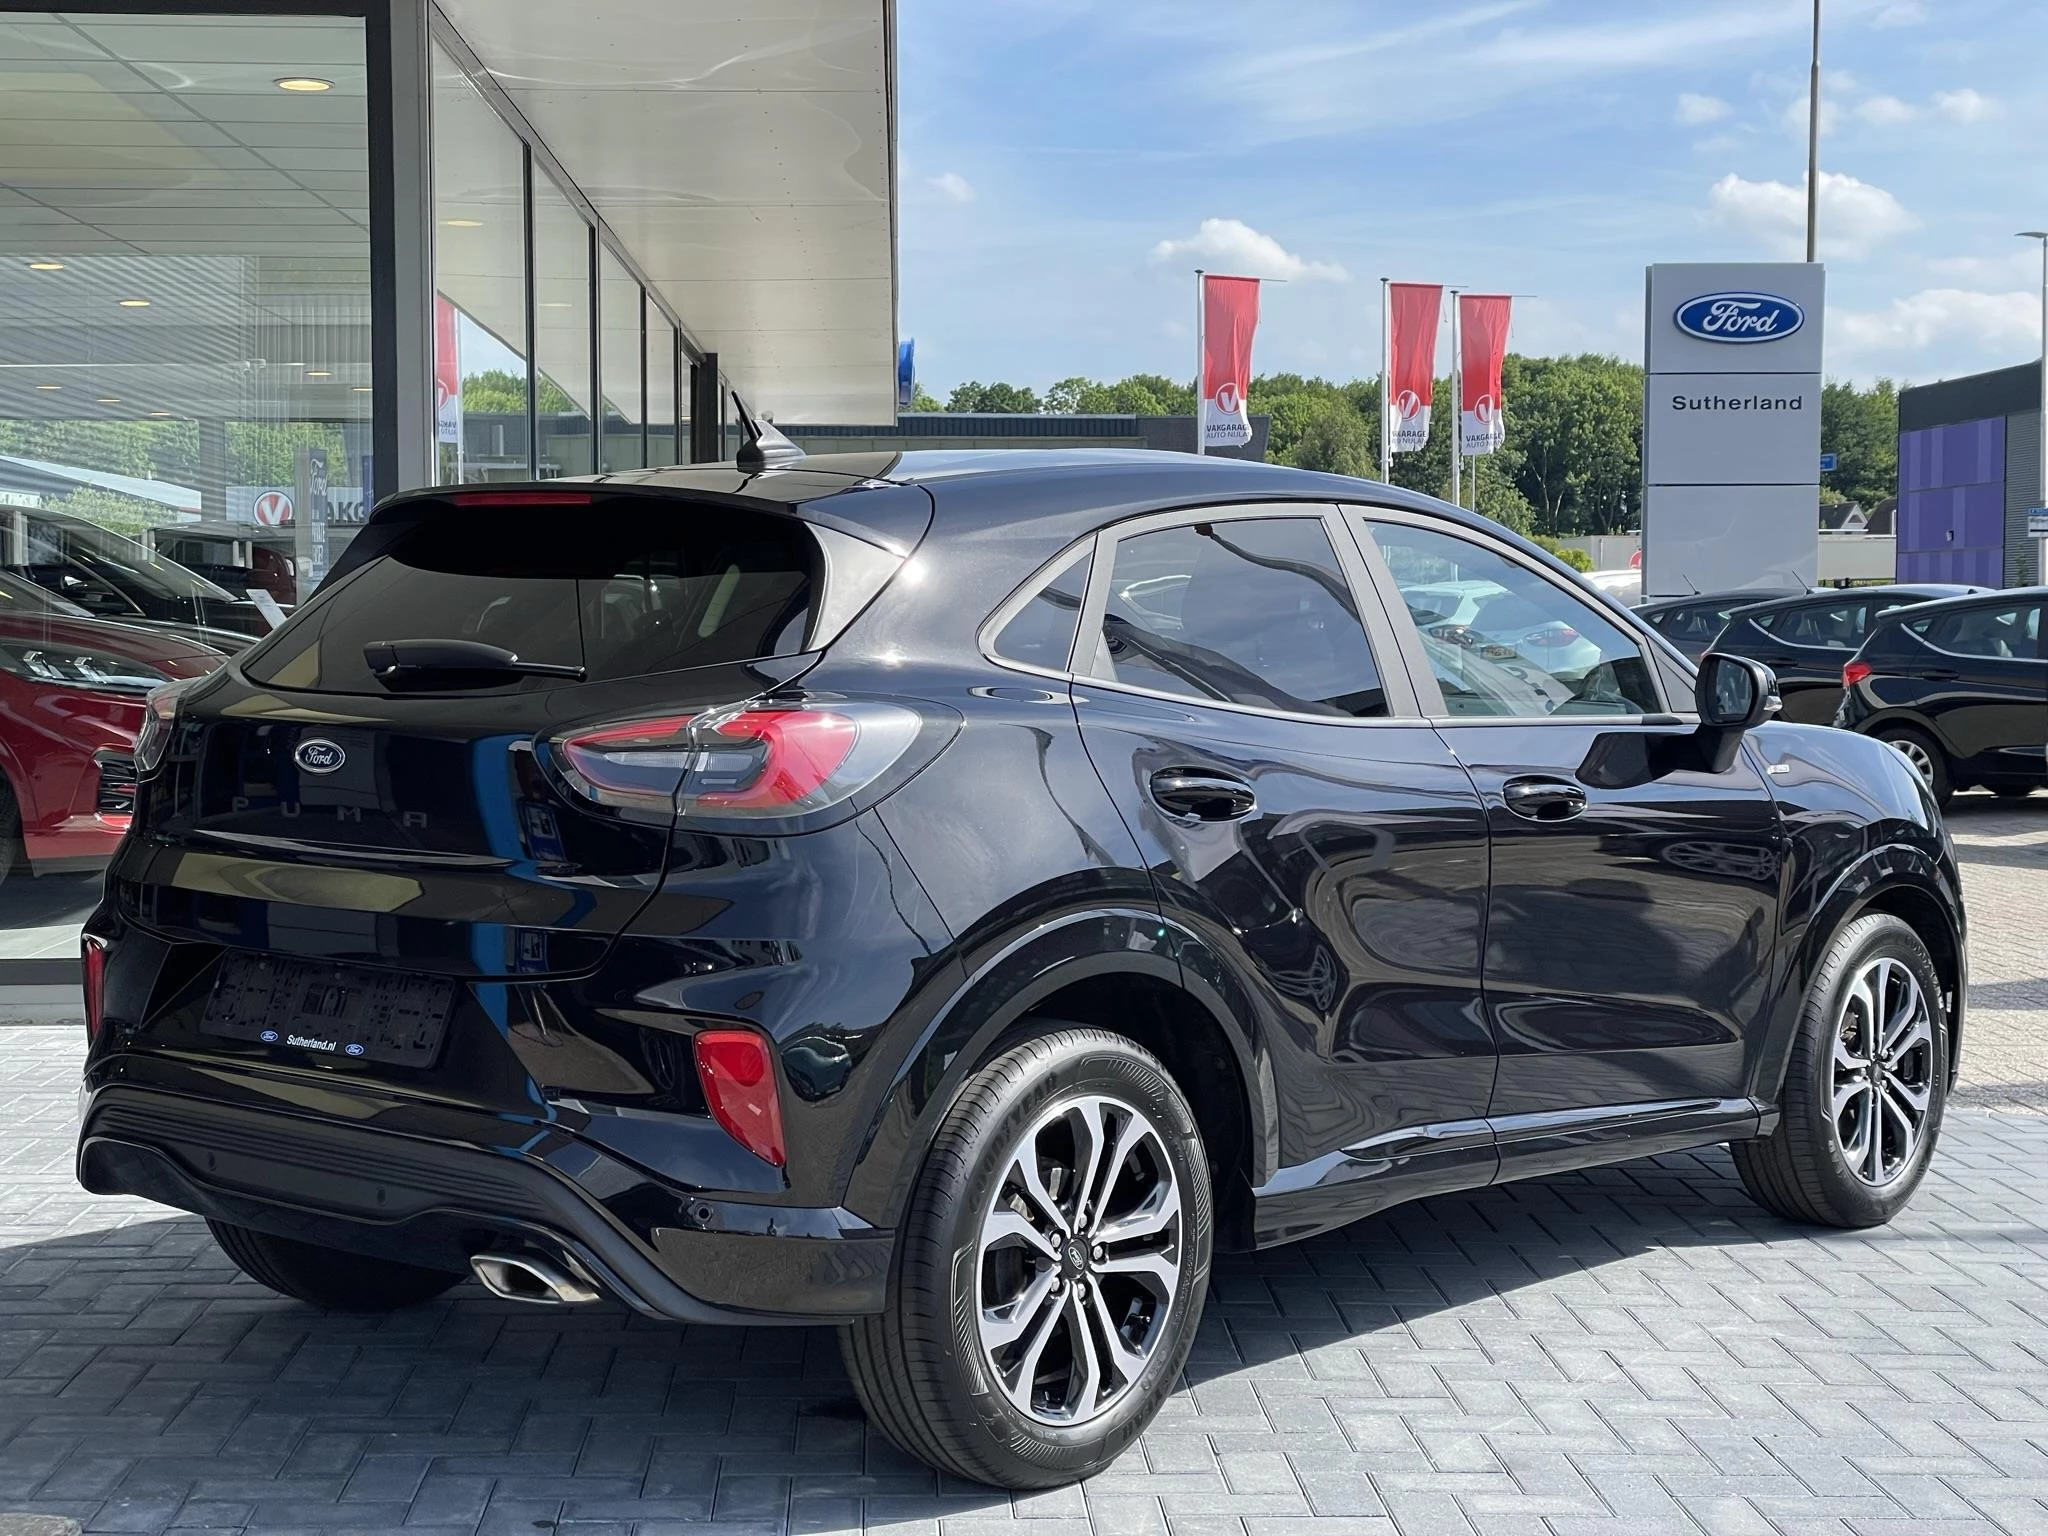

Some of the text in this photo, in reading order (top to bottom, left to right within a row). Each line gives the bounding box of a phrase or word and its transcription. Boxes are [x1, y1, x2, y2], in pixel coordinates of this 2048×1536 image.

[1703, 300, 1780, 332] Ford
[1672, 395, 1802, 410] Sutherland
[306, 746, 333, 765] Ford
[232, 796, 429, 829] PUMA
[286, 1034, 337, 1052] Sutherland.nl
